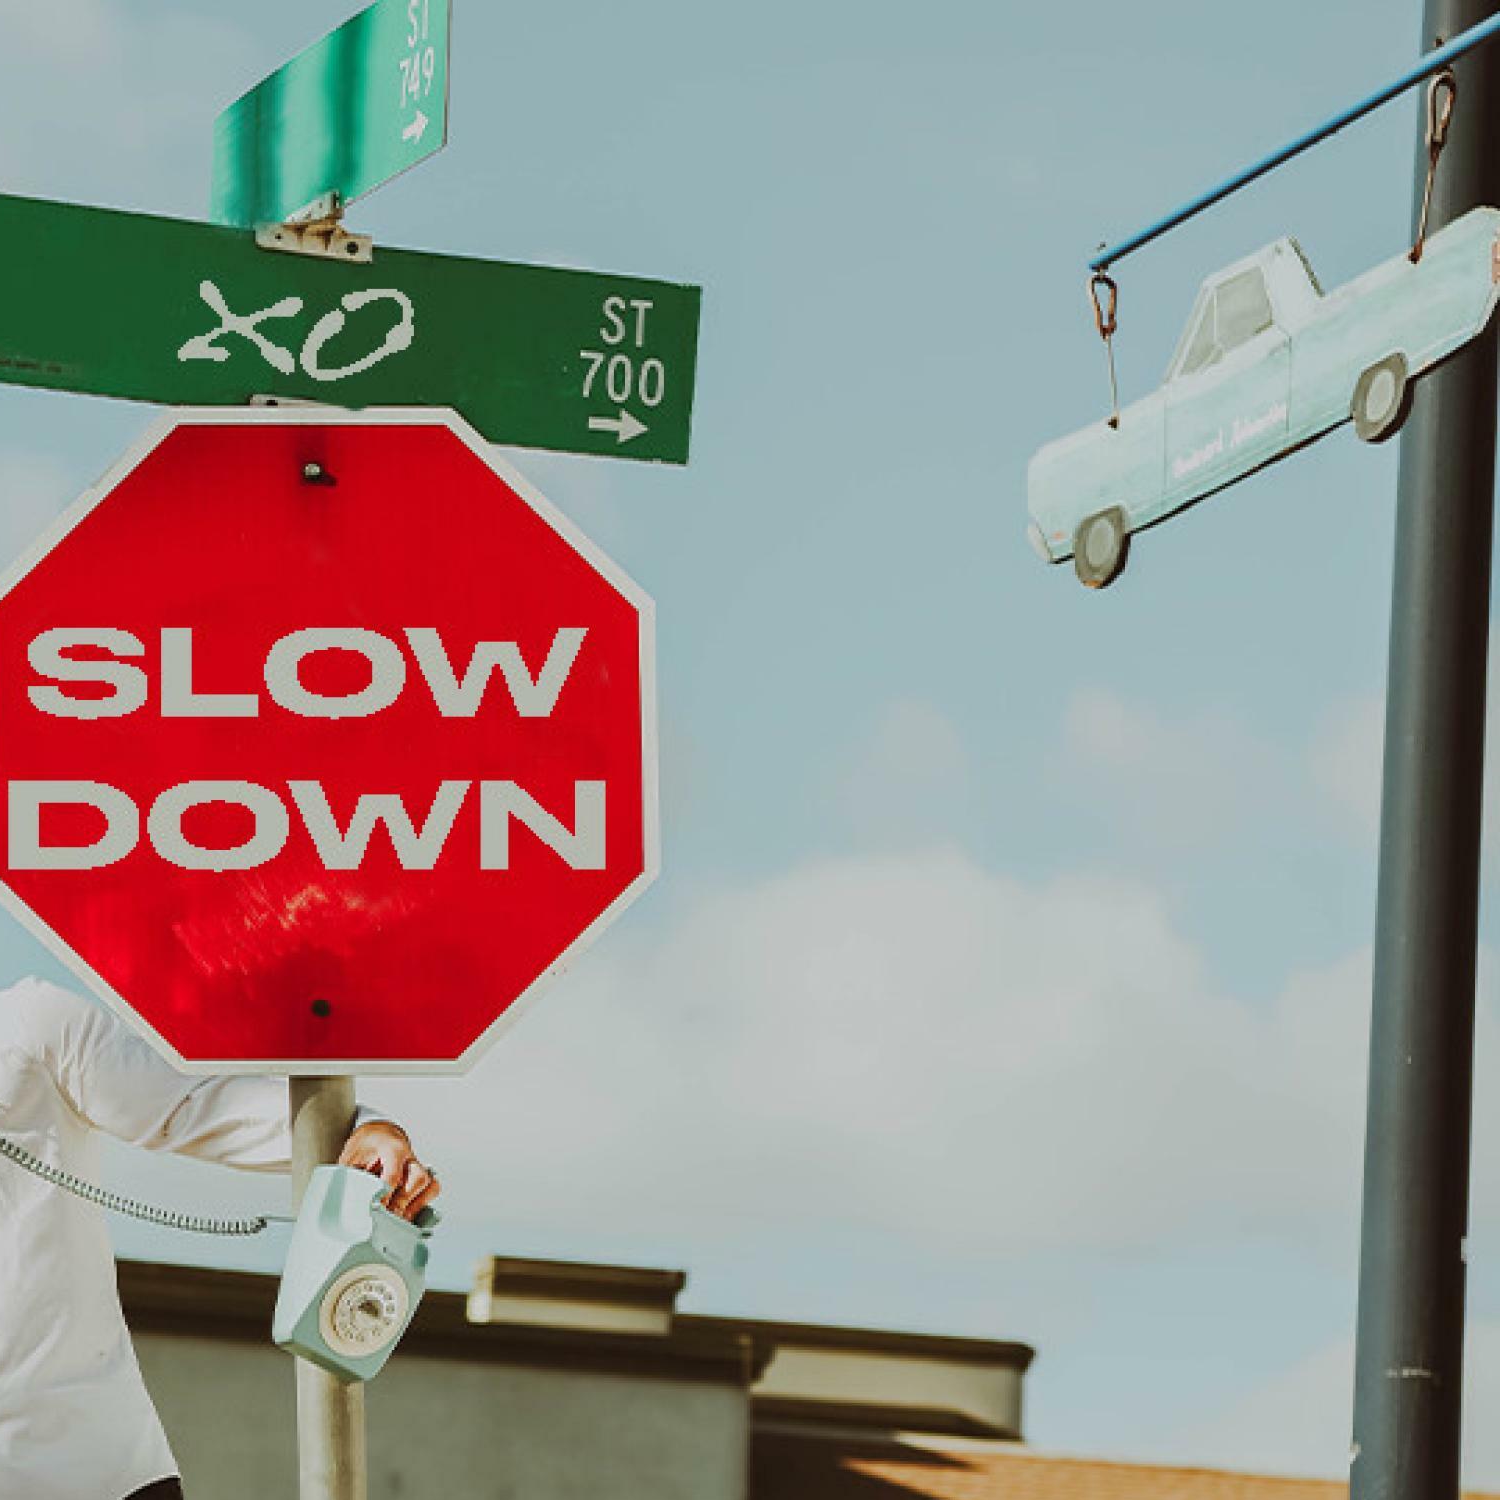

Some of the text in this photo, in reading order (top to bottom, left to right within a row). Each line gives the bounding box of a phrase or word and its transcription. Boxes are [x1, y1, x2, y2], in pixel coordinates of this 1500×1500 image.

[407, 0, 429, 48] ST
[399, 46, 434, 109] 749
[600, 296, 653, 348] ST
[580, 350, 664, 407] 700
[27, 627, 589, 719] SLOW
[8, 780, 606, 871] DOWN
